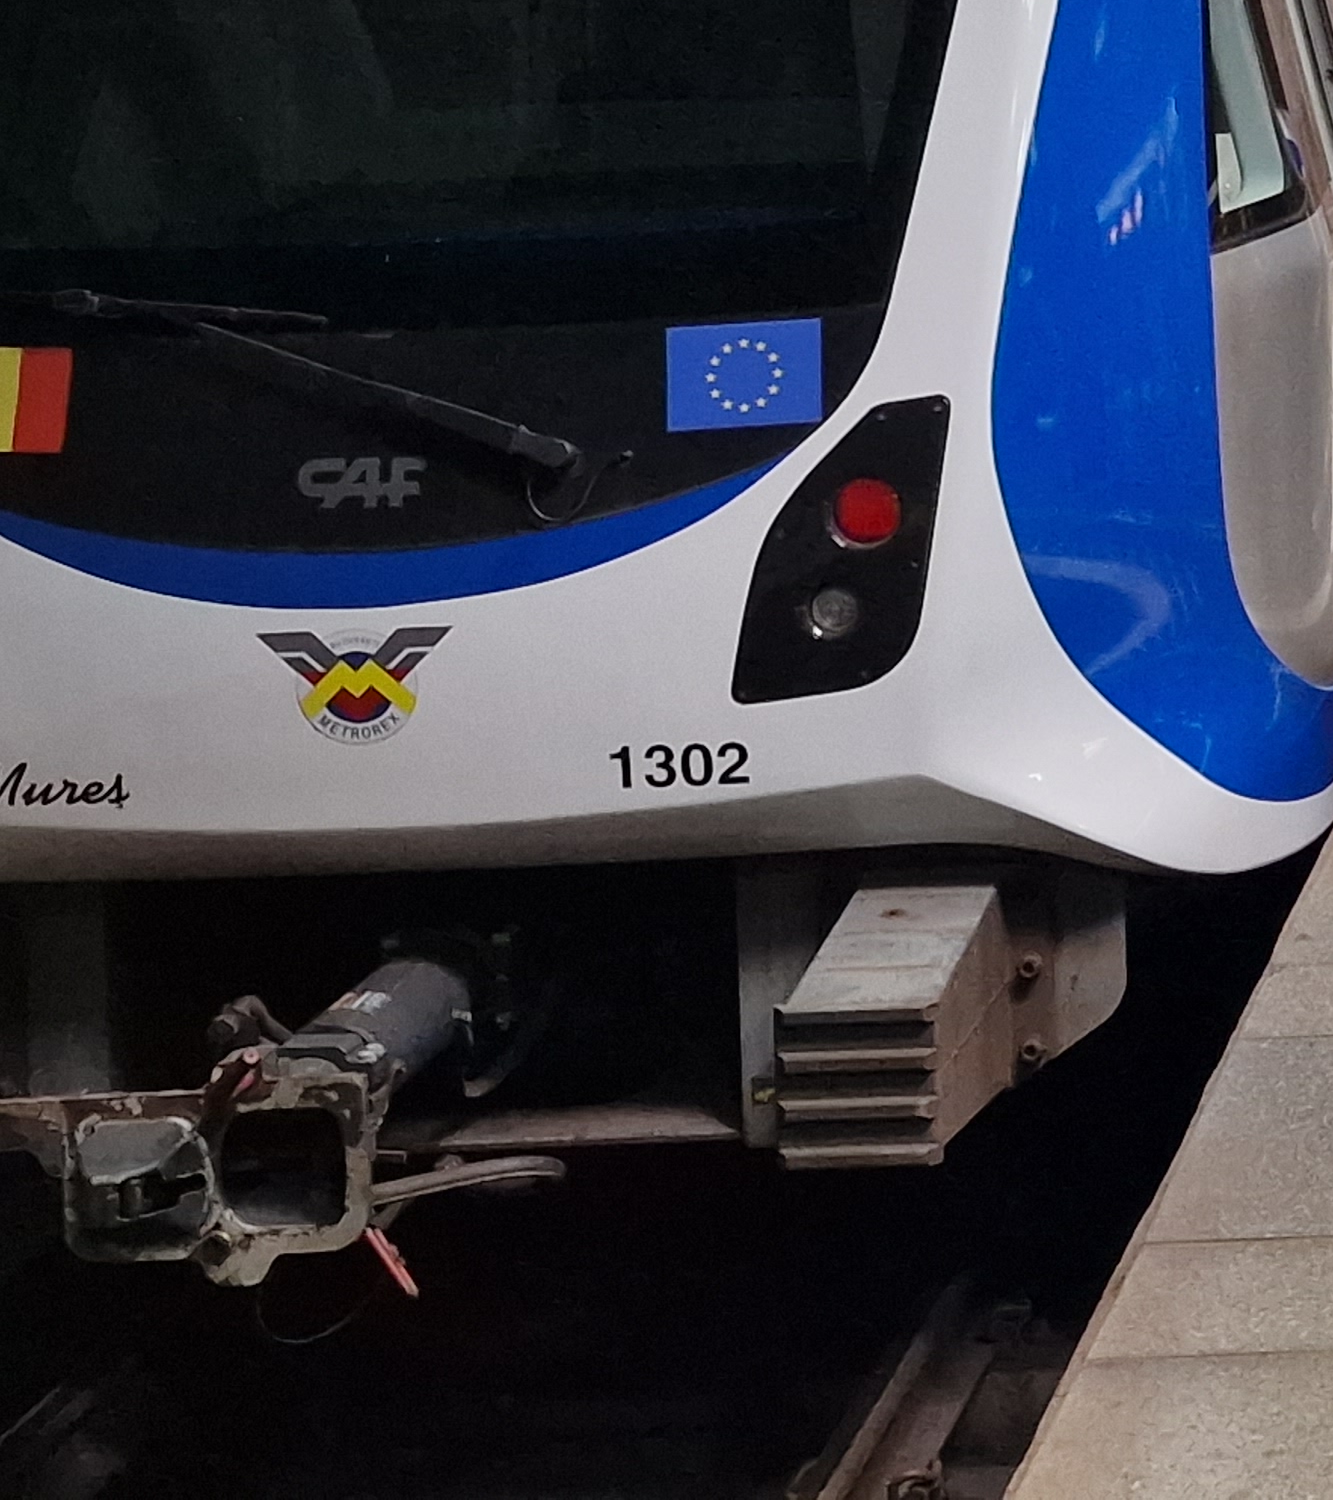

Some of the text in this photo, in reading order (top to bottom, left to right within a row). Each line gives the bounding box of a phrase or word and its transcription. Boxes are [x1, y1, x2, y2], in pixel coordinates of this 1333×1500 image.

[298, 456, 427, 509] CAF
[317, 712, 400, 741] METROREX
[608, 740, 751, 790] 1302
